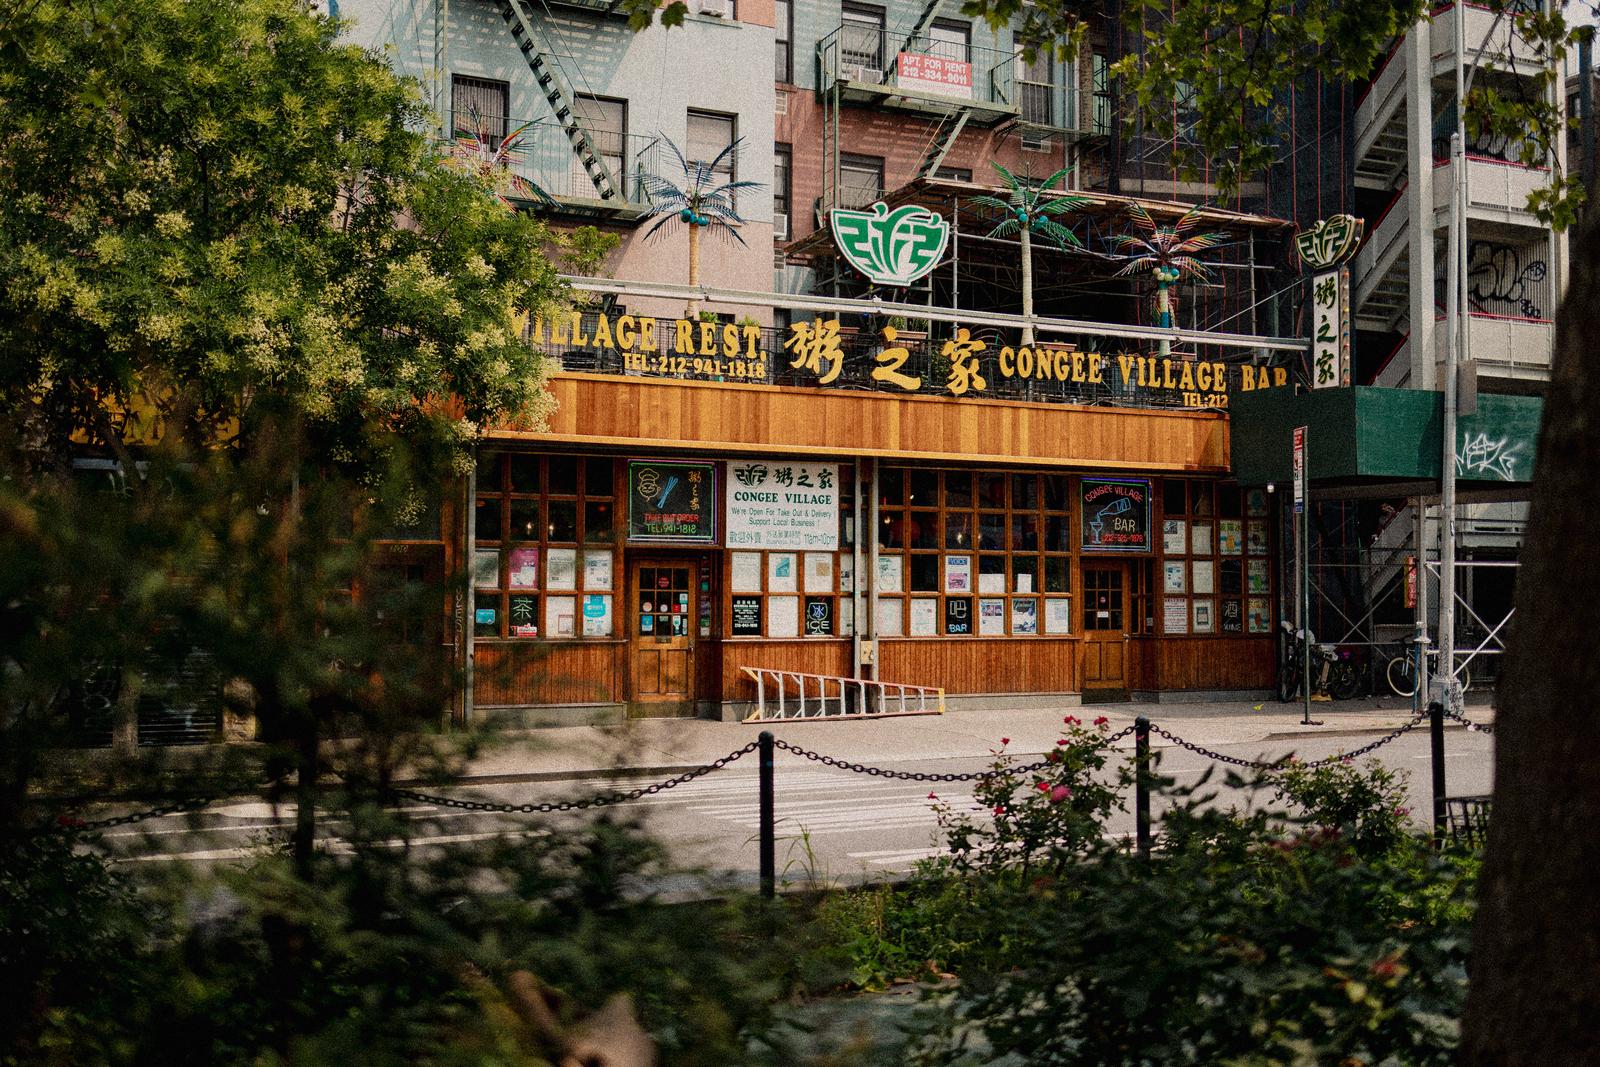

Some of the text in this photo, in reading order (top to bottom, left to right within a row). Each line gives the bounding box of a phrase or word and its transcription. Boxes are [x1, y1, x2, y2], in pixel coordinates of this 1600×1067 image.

[902, 55, 967, 74] APT. FOR RENT
[1313, 276, 1337, 385] 粥之家
[675, 319, 767, 362] REST.
[784, 317, 987, 395] 粥之家
[1000, 346, 1102, 384] CONGEE
[1117, 355, 1227, 392] VILLAGE
[1241, 364, 1287, 391] BAR
[773, 466, 833, 489] 粥之家
[734, 491, 832, 505] CONGEE VILLAGE
[1084, 485, 1143, 503] CONGEE VILLAGE
[731, 507, 747, 515] We're
[749, 508, 763, 517] Open
[765, 508, 775, 516] For
[778, 508, 791, 517] Take
[792, 509, 803, 517] Out
[811, 510, 832, 519] Delivery
[748, 517, 771, 527] Support
[790, 519, 815, 527] Business
[1114, 517, 1136, 533] BAR
[512, 598, 533, 619] 茶
[806, 620, 830, 630] ICE
[949, 624, 968, 633] BAR
